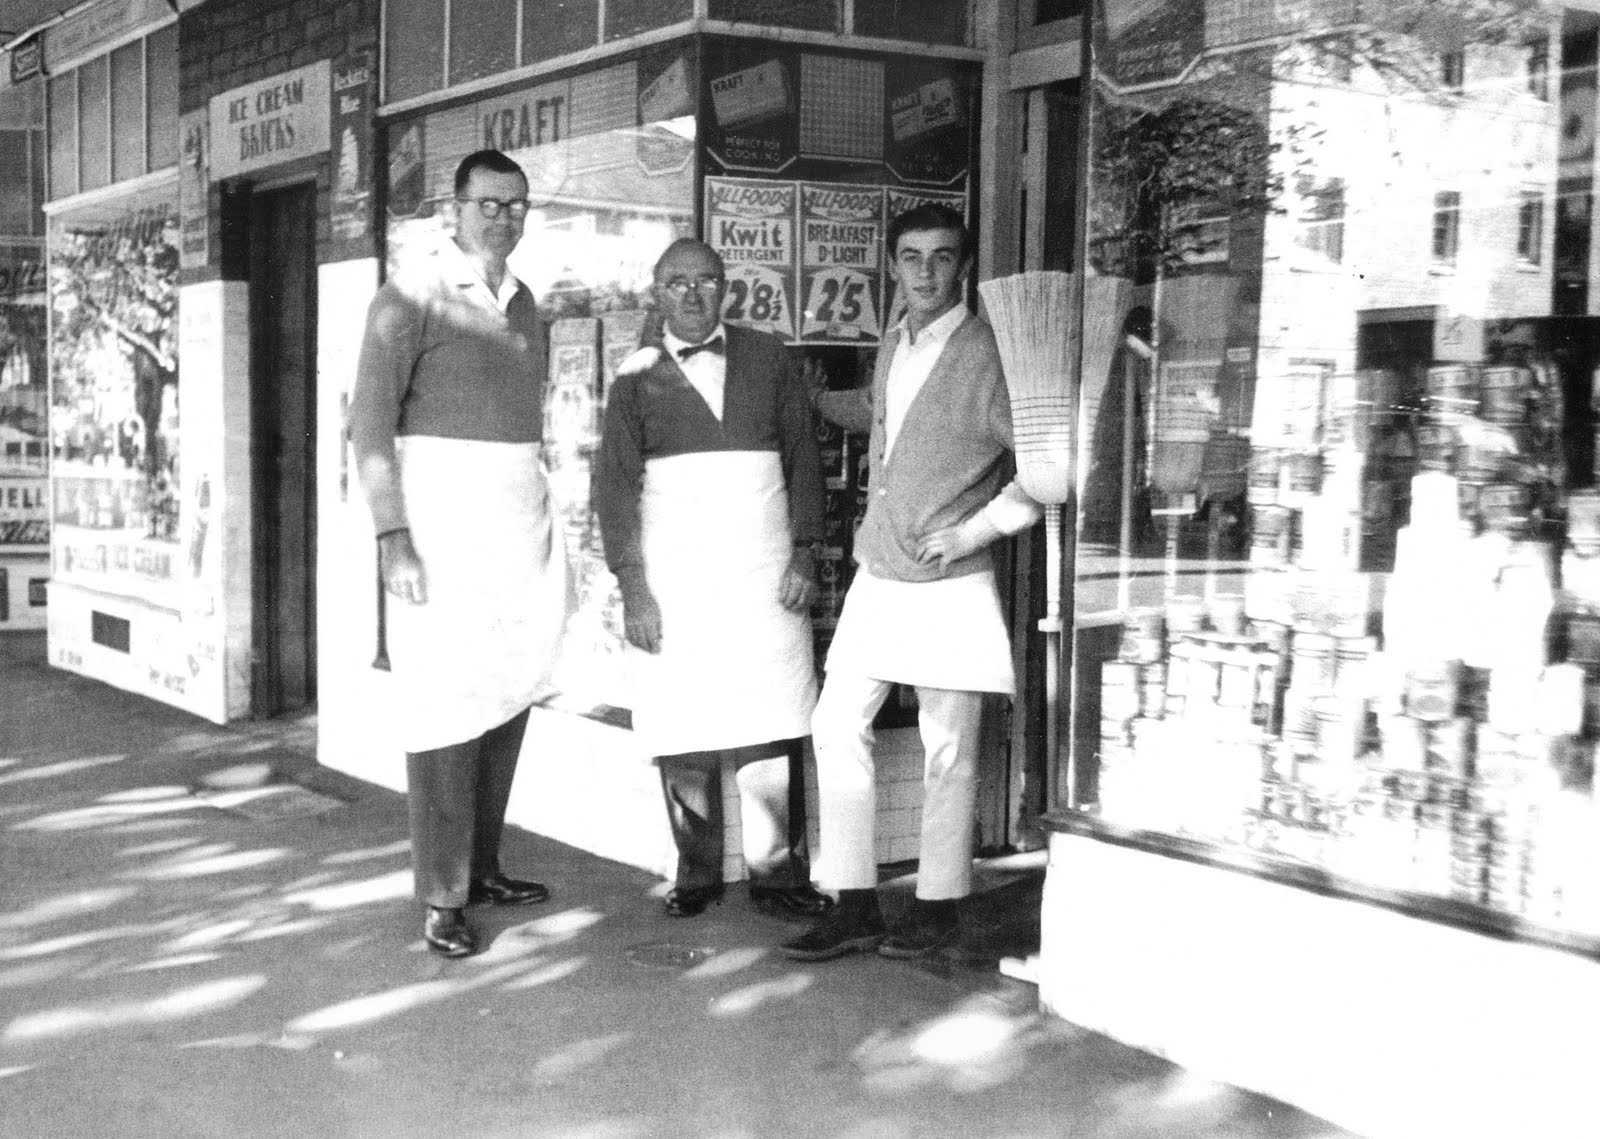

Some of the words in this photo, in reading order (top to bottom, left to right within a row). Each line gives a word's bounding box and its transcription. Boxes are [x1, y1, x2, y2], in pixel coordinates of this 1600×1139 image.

[713, 74, 744, 93] KRAFT
[229, 97, 247, 124] ICE
[256, 78, 304, 115] CREAM
[483, 96, 564, 150] KRAFT
[240, 113, 295, 161] BRICKS
[725, 148, 781, 161] COOKING
[711, 185, 791, 208] ALLFOODS
[805, 190, 881, 213] ALLFOODS
[720, 220, 783, 247] Kwit
[807, 223, 875, 245] BREAKFAST
[718, 248, 784, 261] DETERGENT
